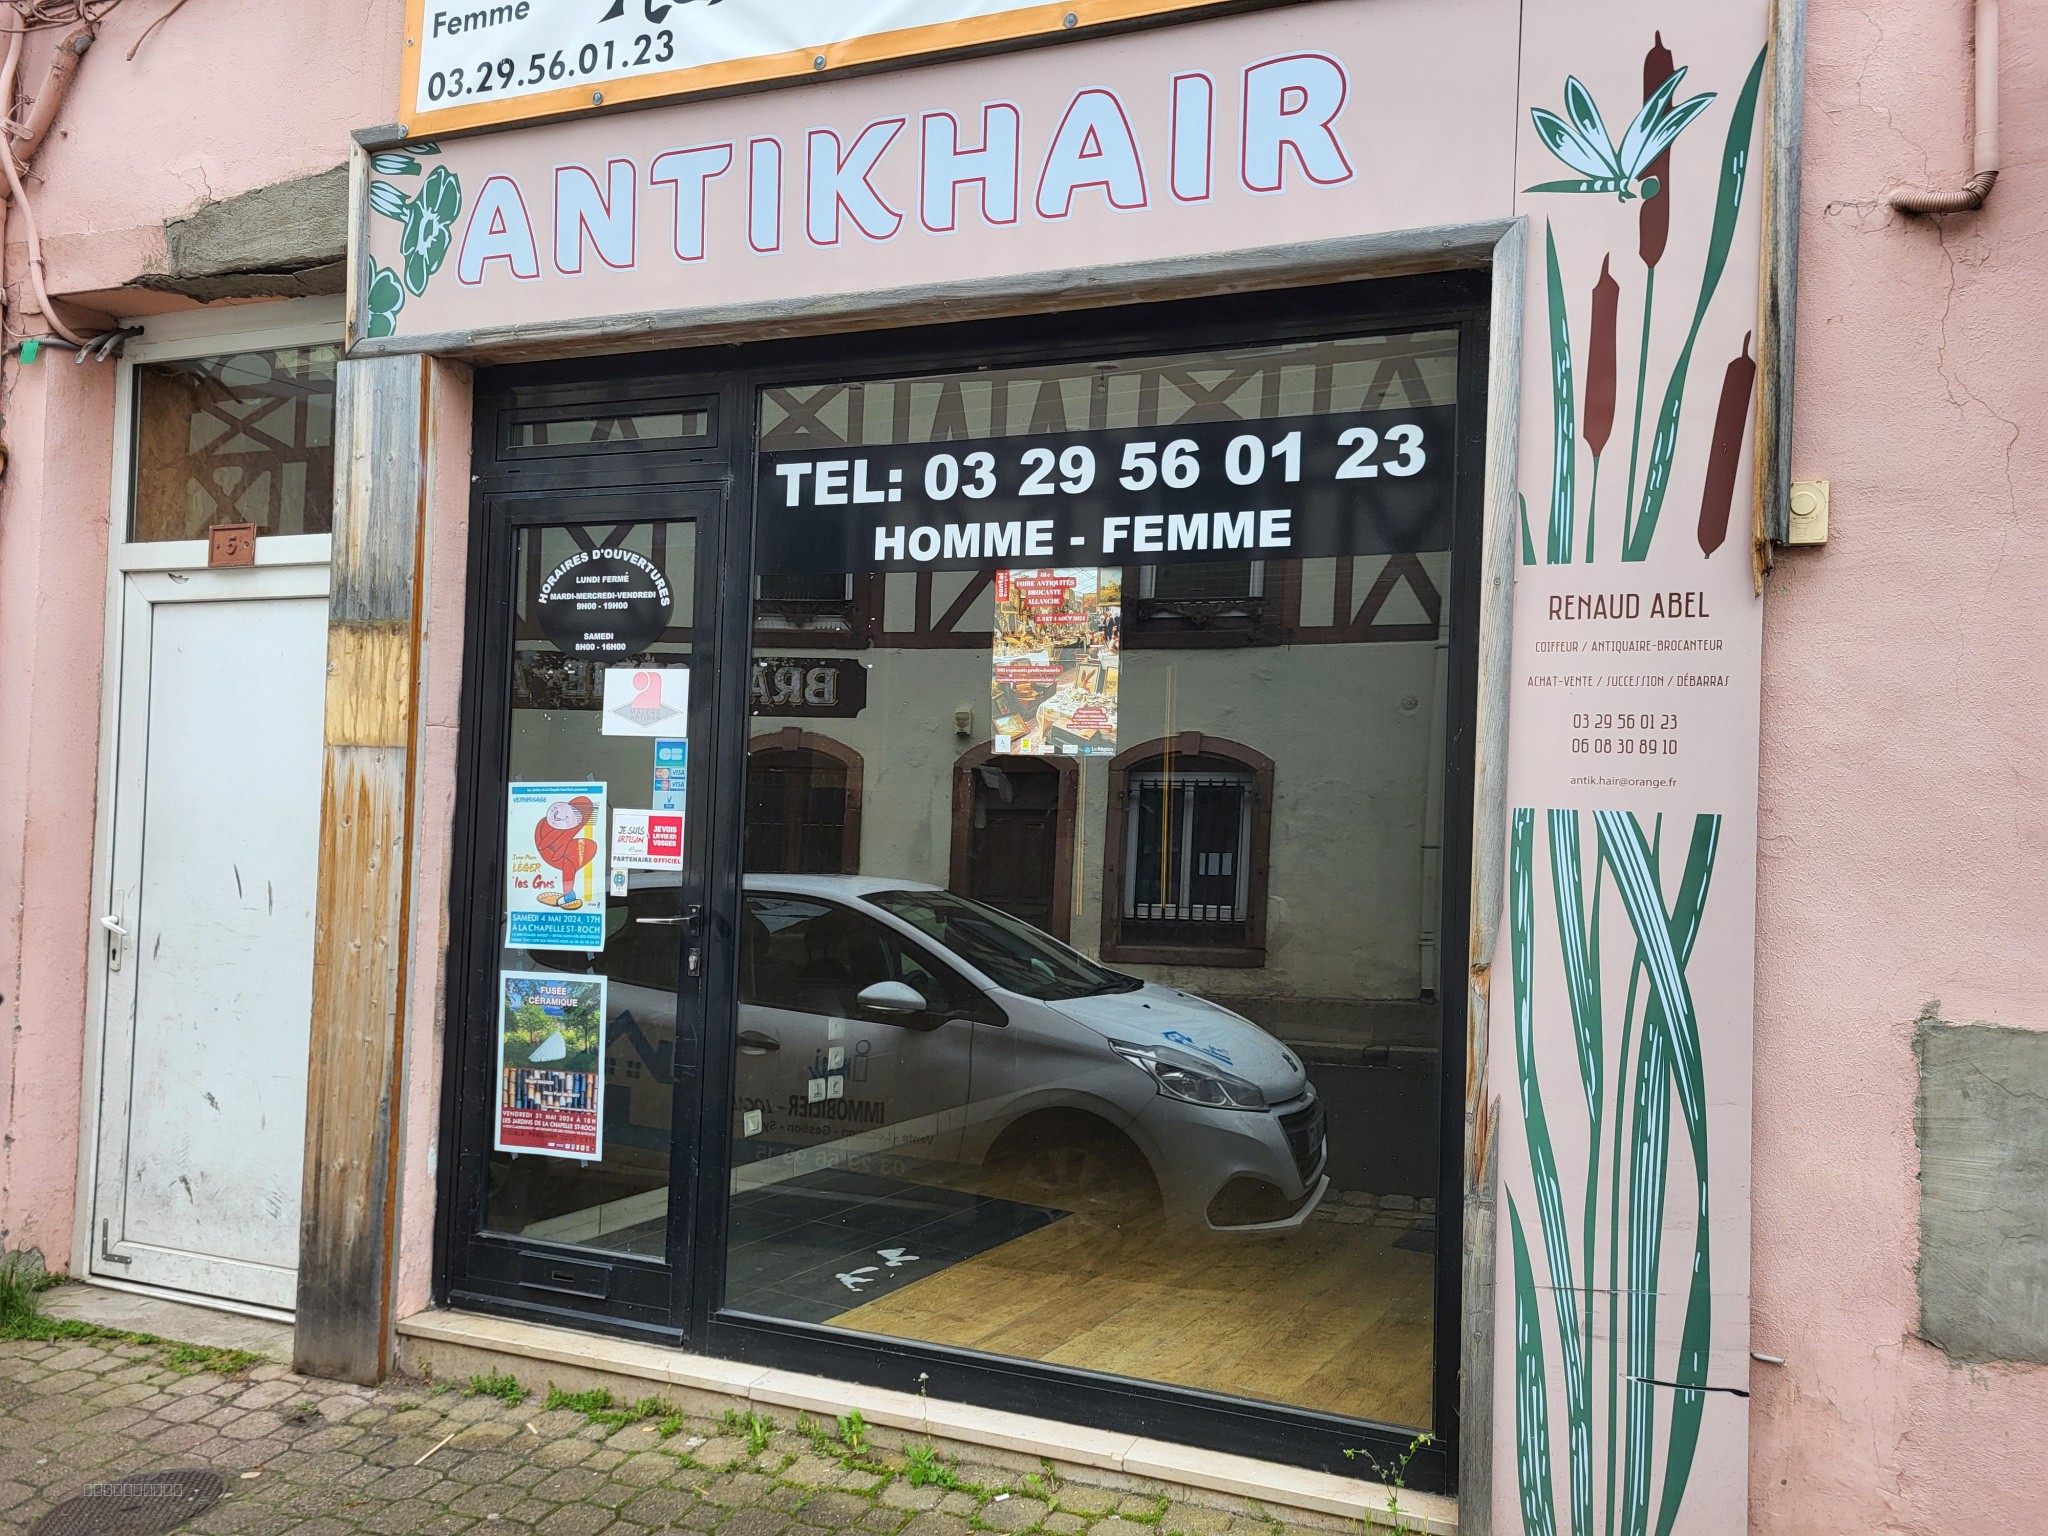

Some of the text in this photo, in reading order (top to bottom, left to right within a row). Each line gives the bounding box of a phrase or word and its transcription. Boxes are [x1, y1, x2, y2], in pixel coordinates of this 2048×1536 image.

[432, 2, 530, 38] Femme
[427, 29, 675, 101] 03.29.56.01.23
[455, 51, 1356, 288] ANTIKHAIR
[776, 424, 1427, 507] TEL: 03 29 56 01 23
[874, 519, 1054, 561] HOMME
[1101, 509, 1292, 553] FEMME
[538, 548, 671, 607] HORAIRES D'OUVERTURES
[575, 571, 630, 584] LUNDI FERMÉ
[550, 591, 657, 601] MARDI-MERCREDI-VENDREDI
[576, 602, 597, 610] 9H00
[603, 602, 629, 610] 19H00
[1548, 592, 1710, 620] RENAUD ABEL
[583, 632, 614, 640] SAMEDI
[575, 643, 596, 651] 8H00
[601, 643, 627, 651] 16H00
[1535, 641, 1579, 652] COIFFEUR
[1591, 639, 1723, 654] ANTIQUAIRE-BROCANTEUR
[1527, 675, 1594, 687] ACHAT-VENTE
[1605, 675, 1664, 687] SUCCESSION
[1676, 672, 1730, 687] DÉBARRAS
[1573, 714, 1678, 730] 03 29 56 01 23
[1571, 738, 1678, 755] 06 08 30 89 10
[1570, 775, 1678, 789] antik.hair@orange.fr
[617, 835, 645, 844] ARTISAN
[613, 855, 682, 865] PARTENAIRE OFFICIEL
[512, 913, 539, 922] SAMEDI
[517, 924, 527, 932] LA
[528, 924, 565, 933] CHAPELLE
[565, 924, 601, 934] ST-ROCH
[540, 985, 567, 996] FUSÉE
[528, 995, 579, 1007] CÉRAMIQUE
[502, 1110, 533, 1118] VENDREDI
[512, 1118, 534, 1126] JARDINS
[549, 1121, 574, 1130] CHAPELLE
